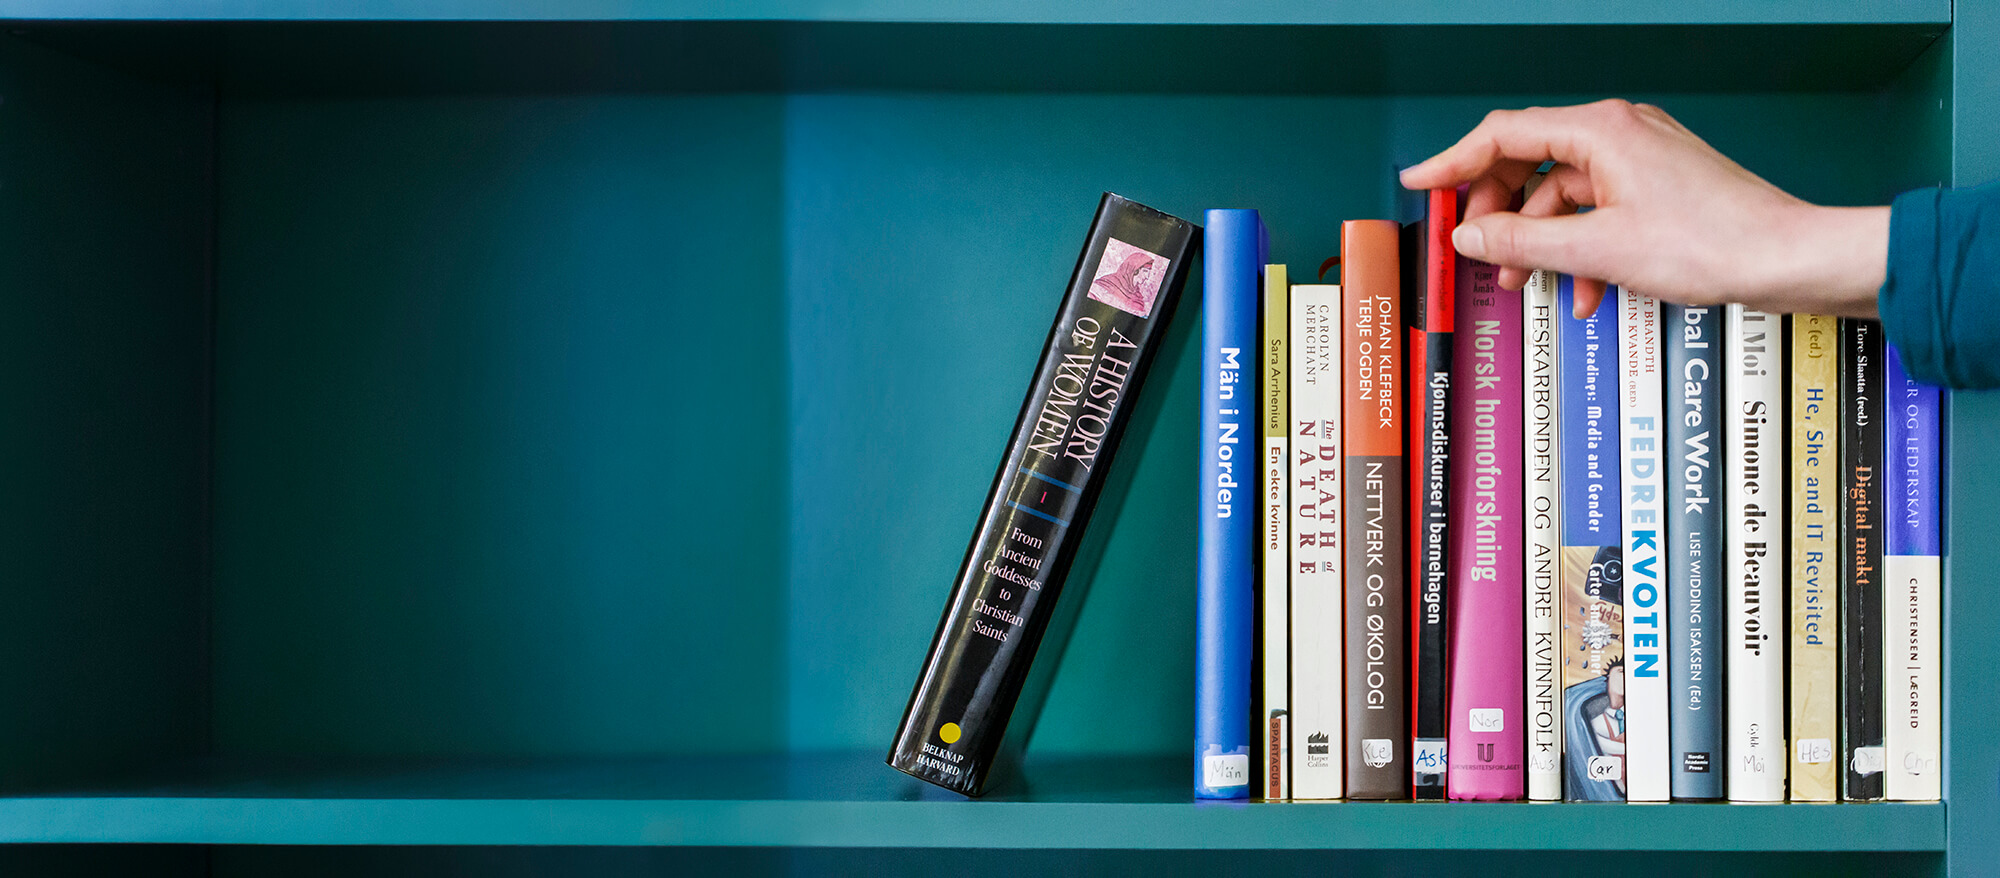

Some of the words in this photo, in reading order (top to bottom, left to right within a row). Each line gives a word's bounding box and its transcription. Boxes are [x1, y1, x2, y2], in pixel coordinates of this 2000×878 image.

[1356, 296, 1372, 337] TERJE
[1376, 295, 1392, 349] JOHAN
[1472, 297, 1495, 307] (red.)
[1684, 304, 1709, 349] bal
[1072, 317, 1100, 350] OF
[1106, 327, 1138, 349] A
[1271, 339, 1281, 365] Sara
[1306, 304, 1316, 385] MERCHANT
[1319, 304, 1330, 372] CAROLYN
[1475, 320, 1501, 390] Norsk
[1628, 325, 1638, 377] KVANDE
[1644, 310, 1655, 373] BRANDTH
[1743, 331, 1767, 377] Moi
[1808, 329, 1823, 359] (ed.)
[1856, 325, 1867, 353] Tore
[1218, 347, 1240, 400] Män
[1359, 342, 1372, 400] OGDEN
[1379, 355, 1392, 429] KLEFBECK
[1532, 305, 1551, 482] FESKARBONDEN
[1584, 343, 1599, 401] Readings:
[1627, 380, 1637, 408] (RED.)
[1684, 358, 1710, 427] Care
[1028, 354, 1096, 460] WOMEN
[1064, 352, 1132, 472] HISTORY
[1271, 367, 1281, 429] Arrhenius
[1805, 388, 1824, 420] He,
[1856, 396, 1869, 427] (red.)
[1906, 404, 1919, 429] OG
[1325, 419, 1335, 439] The
[1429, 371, 1449, 508] Kjønnsdiskurser
[1587, 406, 1602, 449] Media
[1742, 400, 1767, 496] Simone
[1806, 430, 1824, 467] She
[1217, 423, 1239, 519] Norden
[1271, 446, 1281, 464] En
[1588, 454, 1603, 479] and
[1684, 431, 1710, 515] Work
[1270, 468, 1280, 500] ekte
[1299, 420, 1316, 574] NATURE
[1319, 444, 1336, 548] DEATH
[1471, 399, 1502, 581] homoforskning
[1806, 476, 1823, 514] and
[1850, 465, 1872, 530] Digital
[1906, 437, 1919, 528] LEDERSKAP
[1270, 504, 1280, 551] kvinne
[1366, 462, 1384, 567] NETTVERK
[1533, 496, 1551, 530] OG
[1588, 483, 1604, 533] Gender
[1743, 503, 1767, 533] de
[1806, 524, 1823, 542] IT
[998, 544, 1042, 570] Ancient
[1011, 527, 1042, 549] From
[1630, 416, 1659, 677] FEDREKVOTEN
[1689, 532, 1701, 557] LISE
[1856, 536, 1873, 586] makt
[983, 560, 1042, 591] Goddesses
[1326, 561, 1335, 573] of
[1366, 574, 1384, 607] OG
[1424, 522, 1446, 625] barnehagen
[1534, 543, 1552, 618] ANDRE
[1589, 563, 1604, 600] Carter
[1689, 560, 1701, 624] WIDDING
[972, 598, 1024, 627] Christian
[999, 587, 1011, 600] to
[1743, 541, 1768, 656] Beauvoir
[1806, 551, 1823, 645] Revisited
[972, 619, 1009, 642] Saints
[1909, 578, 1918, 661] CHRISTENSEN
[1366, 614, 1384, 710] ØKOLOGI
[1690, 628, 1702, 681] ISAKSEN
[1535, 631, 1553, 753] KVINNFOLK
[1687, 684, 1702, 711] (Ed.)
[1910, 675, 1919, 729] LÆGREID
[916, 754, 960, 776] HARVARD
[922, 742, 964, 764] BELKNAP
[1271, 722, 1279, 787] SPARTACUS
[1416, 747, 1448, 767] Ask
